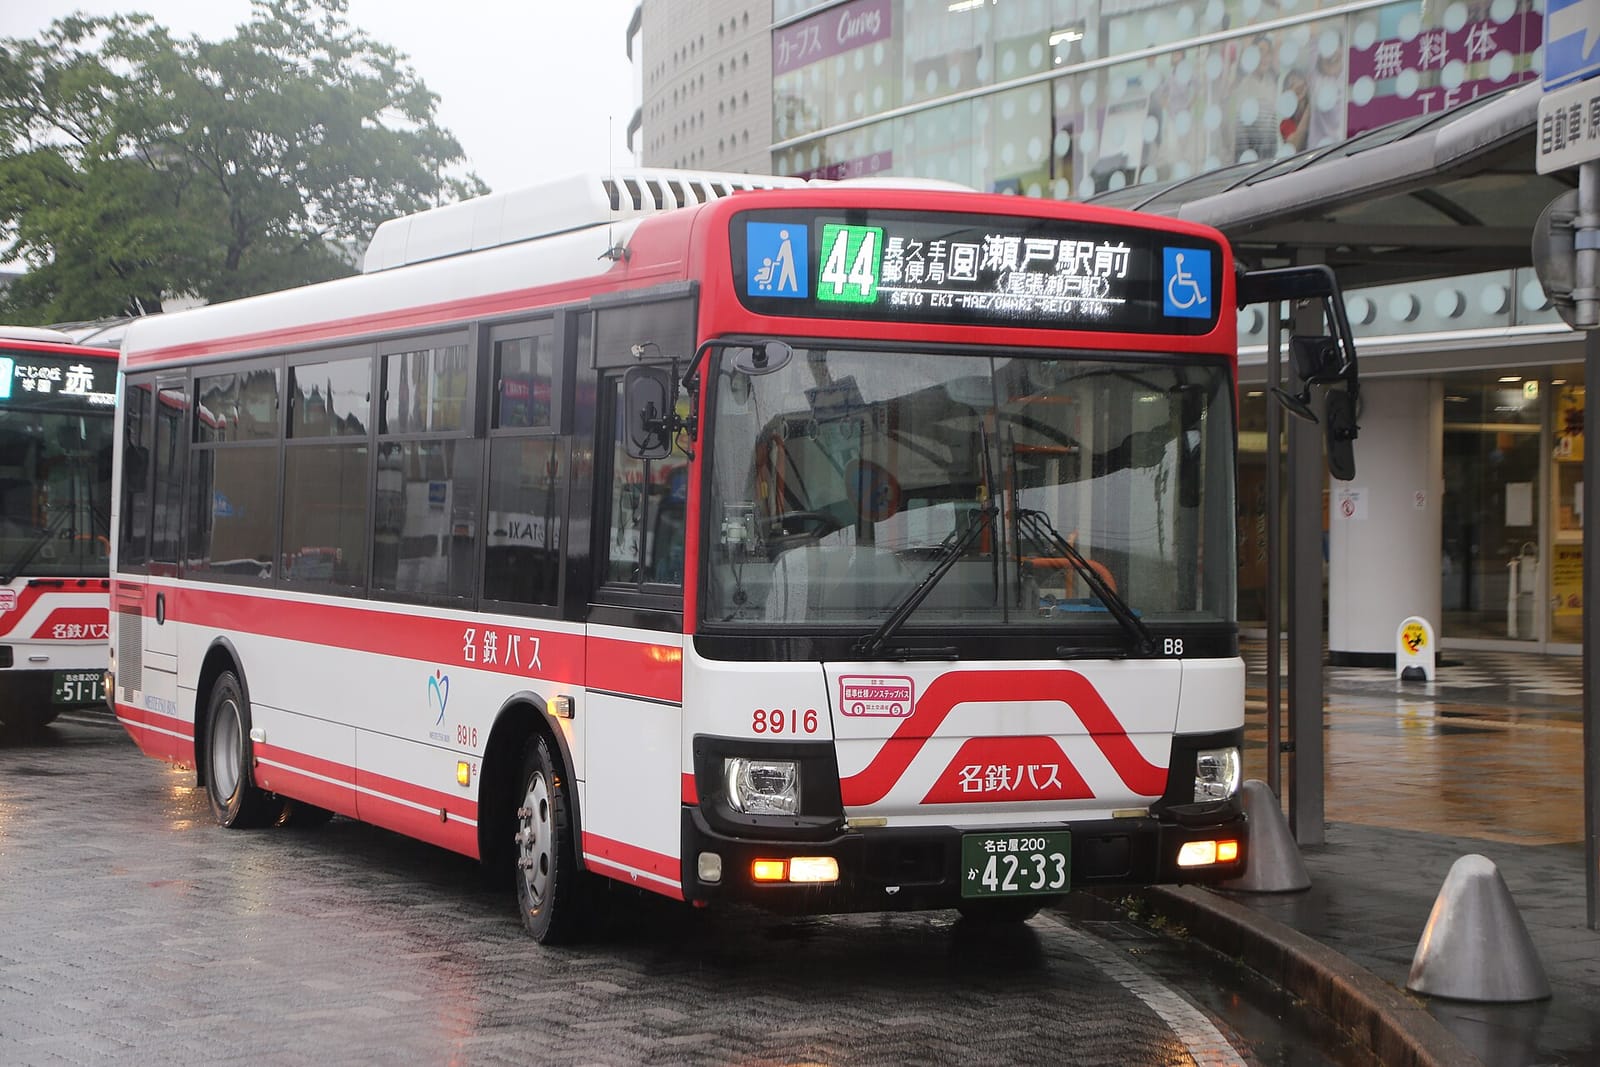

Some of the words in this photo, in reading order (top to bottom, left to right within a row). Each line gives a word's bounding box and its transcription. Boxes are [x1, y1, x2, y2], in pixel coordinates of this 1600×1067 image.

[837, 9, 881, 45] Curves
[1374, 23, 1499, 79] 無料体
[821, 229, 875, 297] 44
[884, 236, 947, 263] 長久手
[979, 233, 1131, 279] 瀬戸駅前
[880, 259, 946, 285] 郵便局
[890, 291, 923, 305] SETO
[65, 363, 95, 393] 赤
[52, 623, 109, 639] 名鉄バス
[463, 628, 542, 672] 名鉄バス
[1164, 638, 1184, 655] B8
[752, 709, 818, 734] 8916
[457, 724, 477, 748] 8916
[959, 764, 1062, 793] 名鉄バス
[984, 838, 1046, 853] 名古屋200
[967, 867, 980, 880] か
[982, 853, 1066, 892] 42-33
